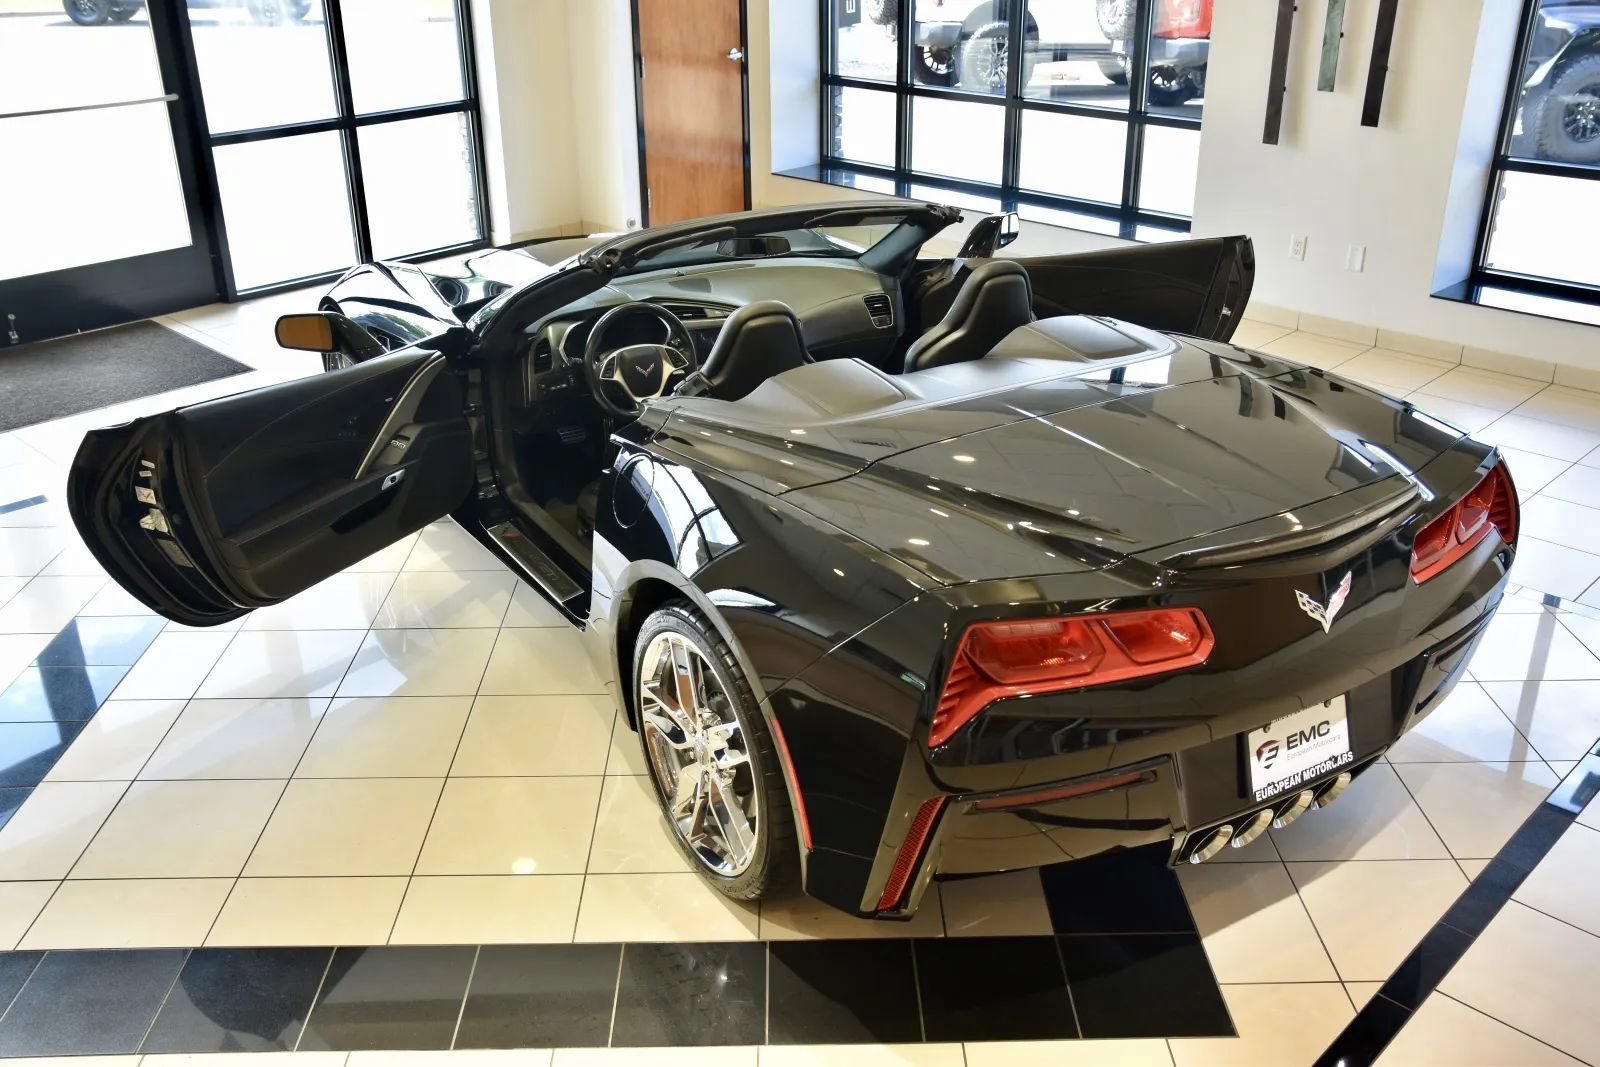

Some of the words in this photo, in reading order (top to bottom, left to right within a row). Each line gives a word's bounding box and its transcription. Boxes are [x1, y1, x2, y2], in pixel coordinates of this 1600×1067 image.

[1286, 720, 1330, 751] EMC
[1255, 775, 1302, 801] EUROPEAN
[1303, 751, 1354, 780] MOTORCARS
